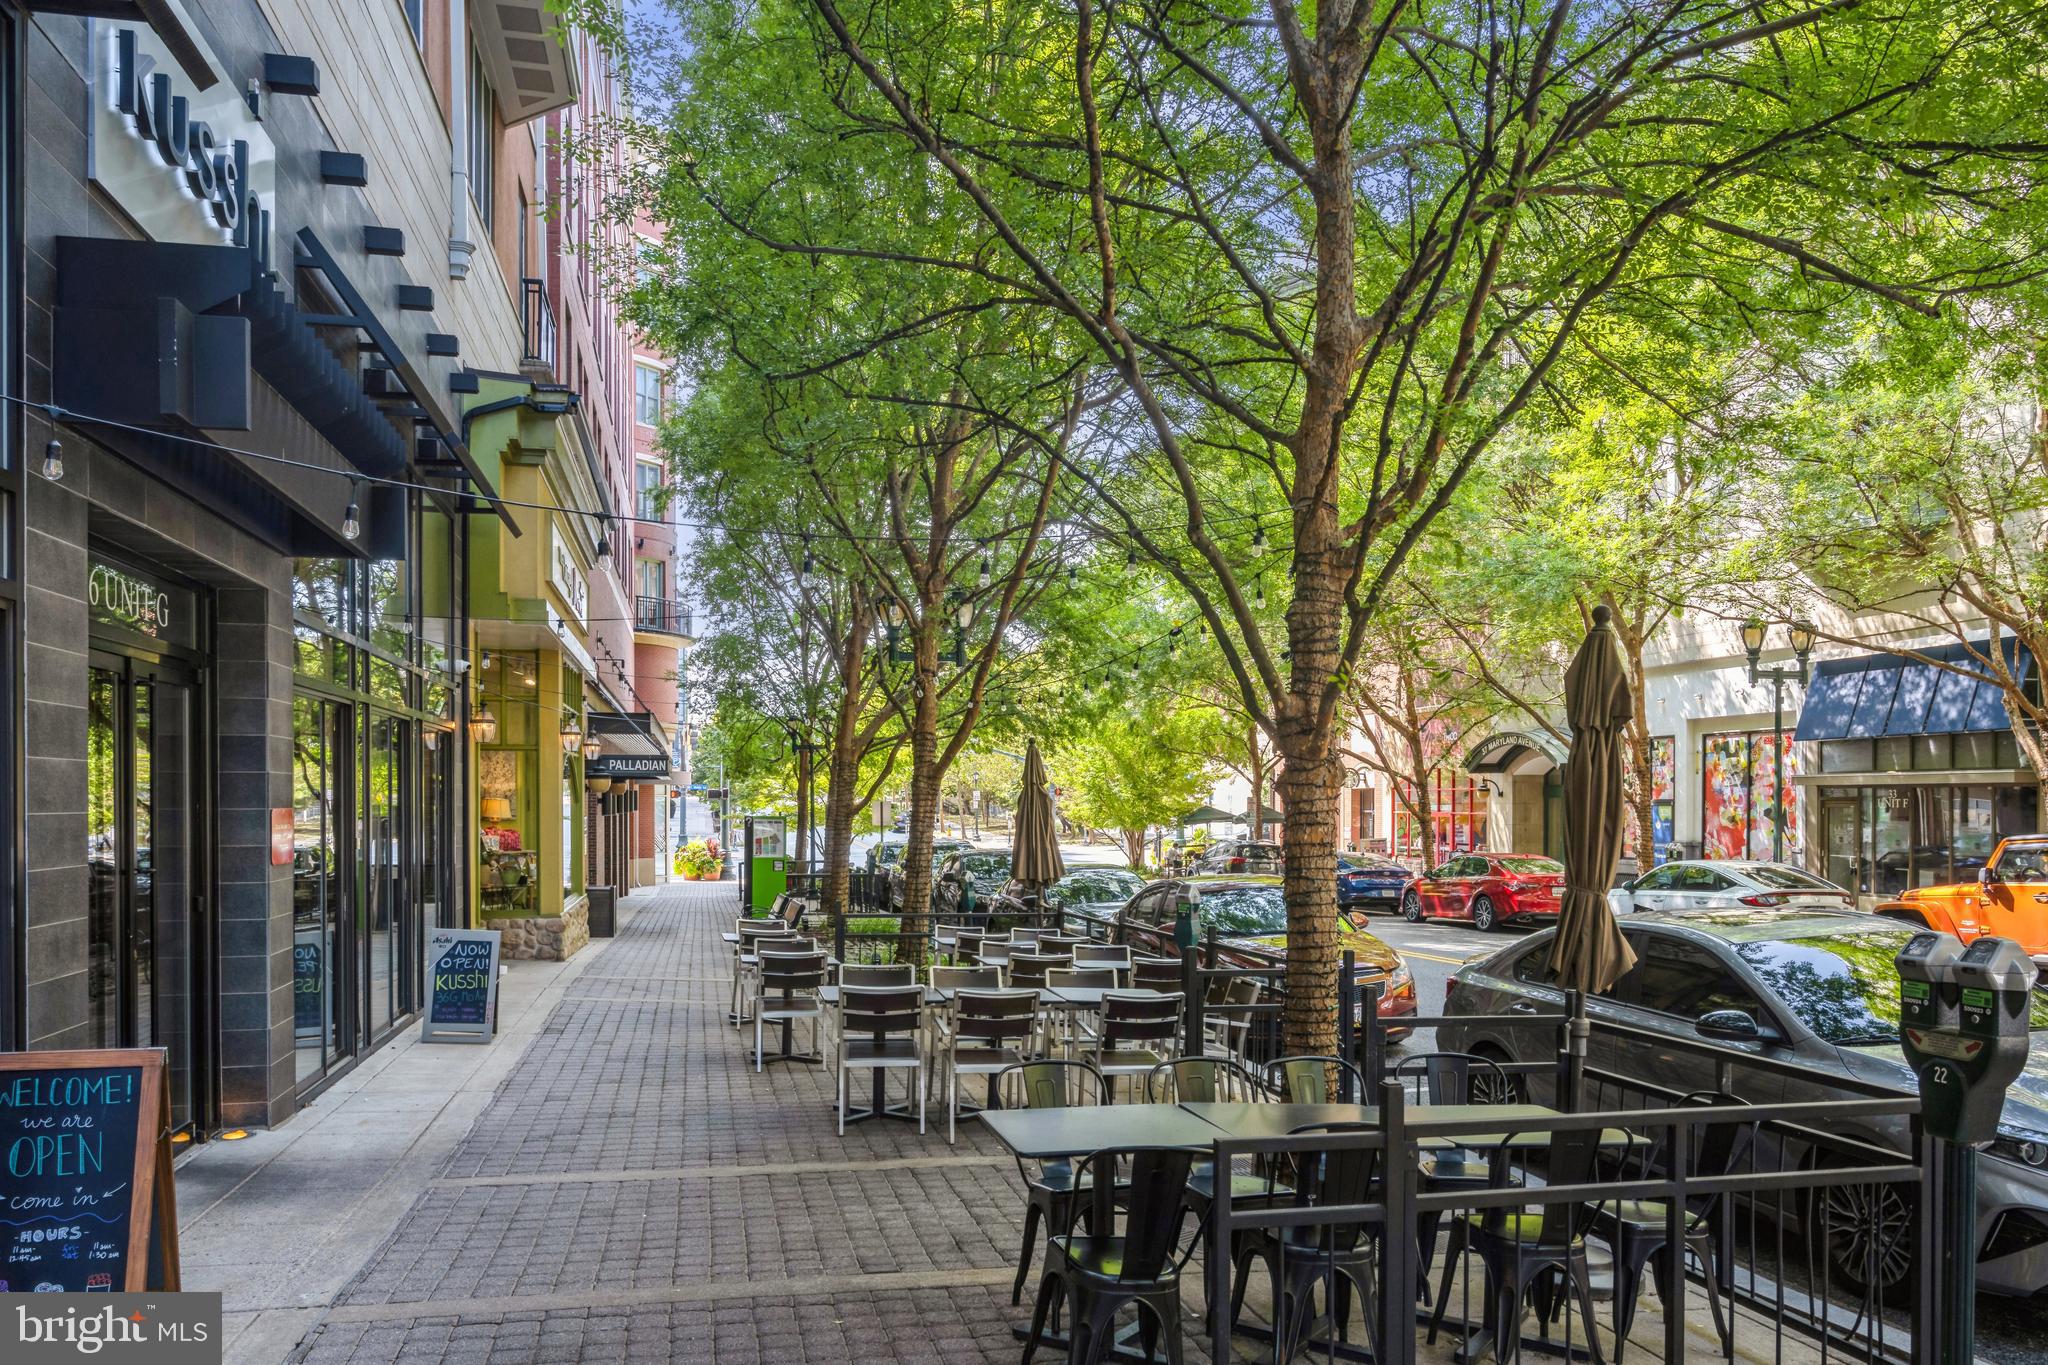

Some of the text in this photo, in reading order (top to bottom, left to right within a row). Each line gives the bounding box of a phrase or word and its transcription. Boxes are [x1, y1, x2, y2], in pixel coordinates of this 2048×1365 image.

[105, 572, 153, 622] UNIT
[157, 593, 168, 627] G
[1488, 735, 1518, 751] MARYLAND
[1518, 736, 1541, 753] AVENUE
[609, 760, 666, 771] PALLADIAN
[1888, 789, 1898, 799] 33
[1877, 798, 1909, 809] UNIT F
[455, 943, 490, 957] NOW
[440, 957, 489, 970] OPEN!
[1934, 1066, 1948, 1084] 22
[0, 1074, 132, 1107] WELCOME!
[20, 1114, 95, 1129] we are
[9, 1131, 103, 1178] OPEN
[10, 1187, 99, 1210] come in
